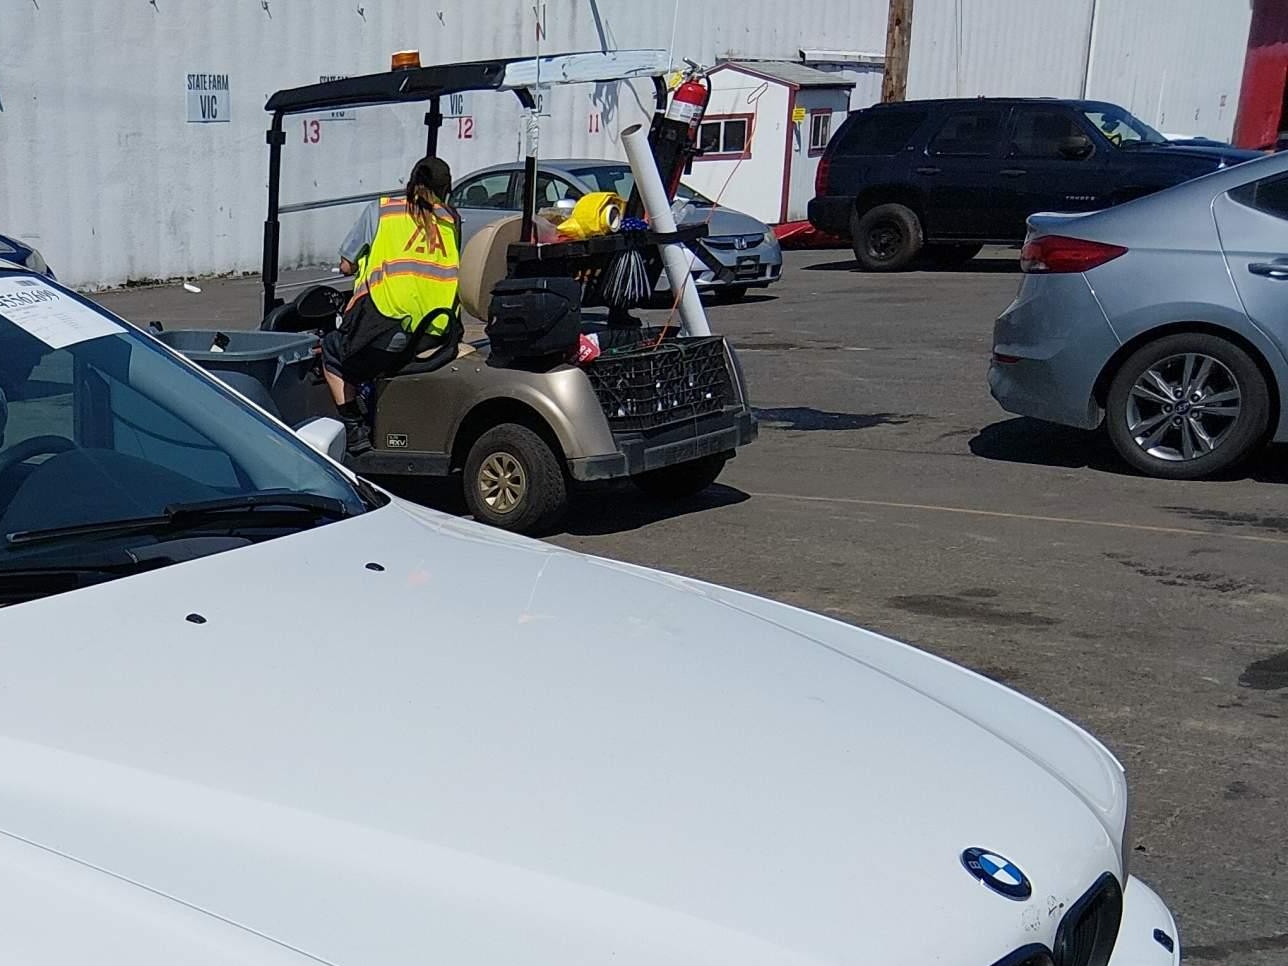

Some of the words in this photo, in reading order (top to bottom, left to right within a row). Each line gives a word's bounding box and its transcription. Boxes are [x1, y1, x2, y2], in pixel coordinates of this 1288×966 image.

[187, 74, 208, 90] STATE
[209, 74, 229, 91] FARM
[199, 95, 218, 119] VIC
[450, 94, 464, 115] VIC
[303, 120, 321, 144] 13
[457, 117, 473, 139] 12
[588, 114, 600, 133] 11
